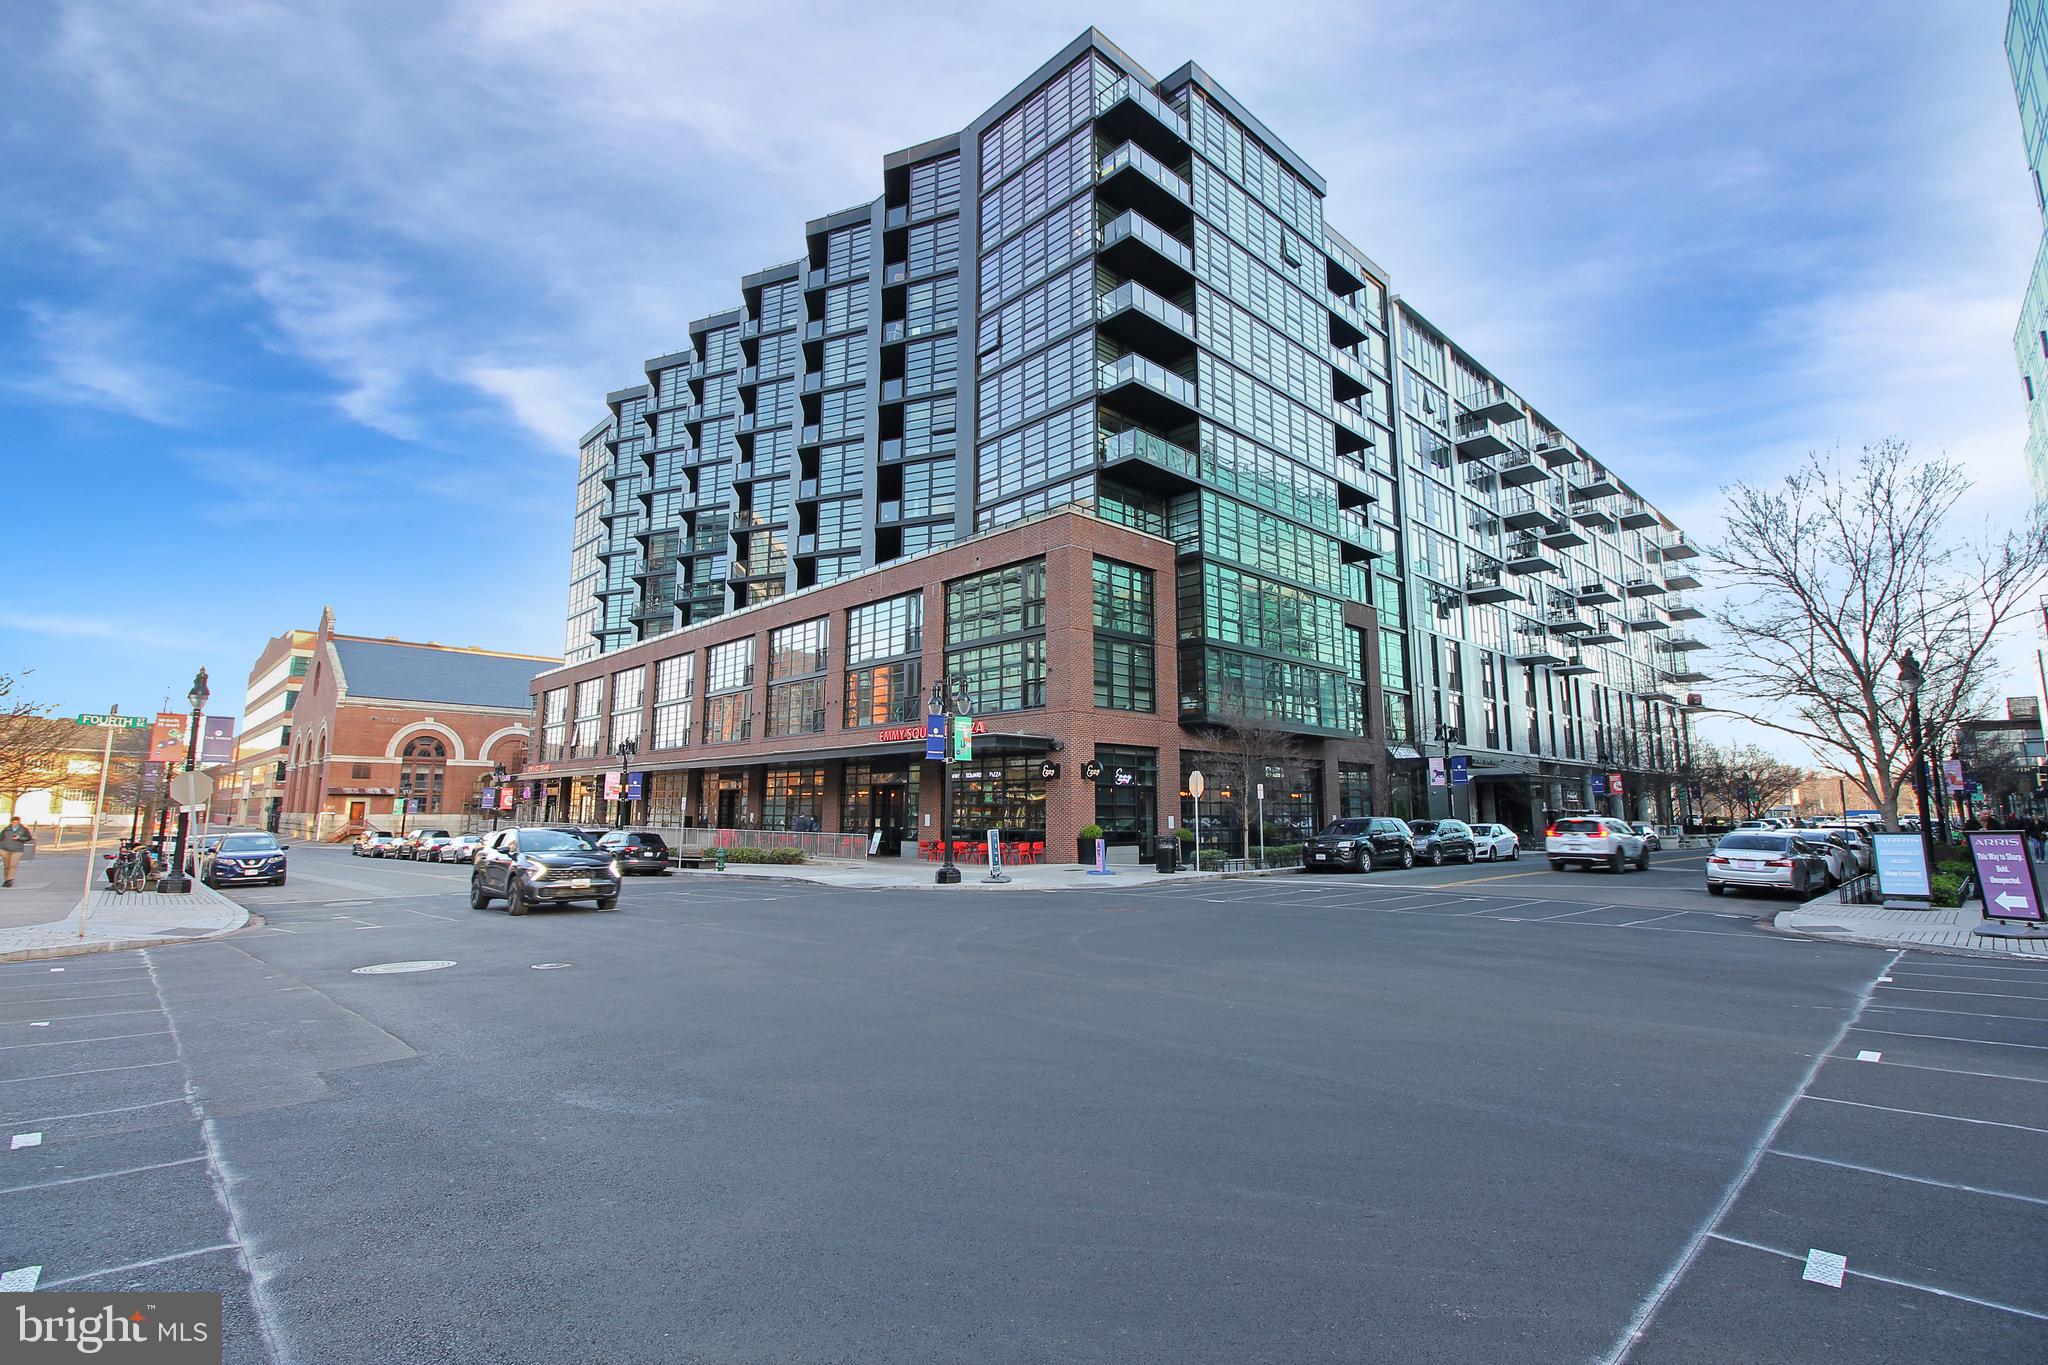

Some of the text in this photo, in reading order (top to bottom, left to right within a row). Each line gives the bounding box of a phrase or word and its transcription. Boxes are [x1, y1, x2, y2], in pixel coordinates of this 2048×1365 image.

[83, 715, 133, 726] FOURTH
[880, 729, 906, 742] EMMY
[1988, 852, 2000, 862] Way
[1996, 864, 2010, 872] Bold.
[1990, 876, 2022, 885] Unexpected.
